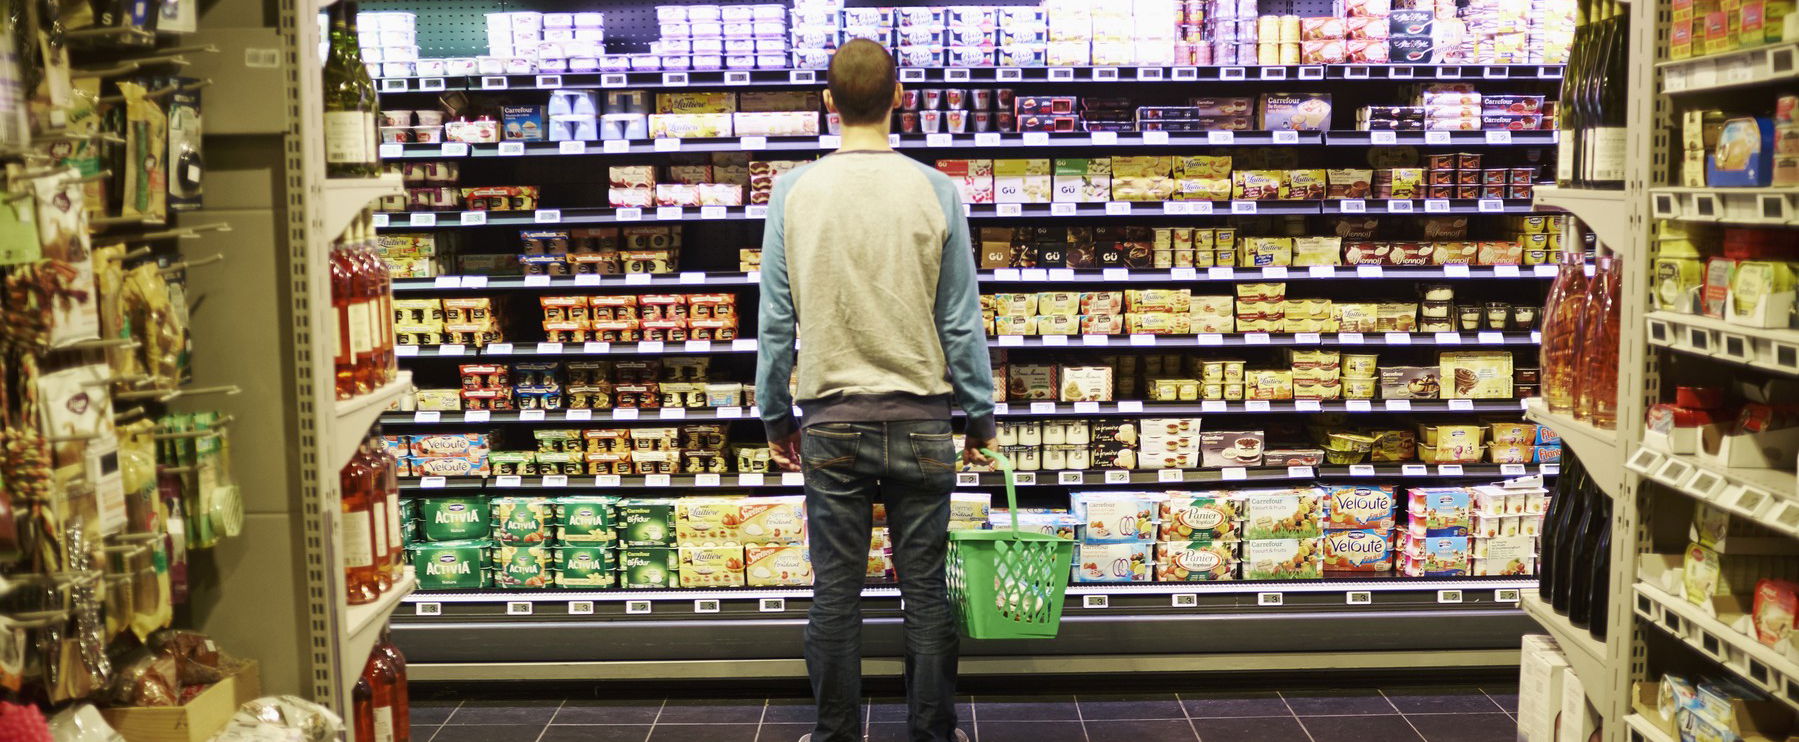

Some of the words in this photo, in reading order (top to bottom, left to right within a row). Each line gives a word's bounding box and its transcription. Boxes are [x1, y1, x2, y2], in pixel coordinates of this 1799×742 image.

[428, 440, 465, 449] Velouté
[430, 461, 467, 471] Velouté
[1336, 495, 1388, 510] Velouté
[435, 509, 479, 524] ACTIVIA
[1188, 507, 1218, 520] Panier
[507, 520, 537, 530] ACTIVIA
[569, 515, 603, 526] ACTIVIA
[1330, 538, 1382, 553] Velouté
[1184, 550, 1215, 562] Panier
[426, 561, 471, 575] ACTIVIA
[509, 564, 538, 573] ACTIVIA
[567, 559, 600, 570] ACTIVIA
